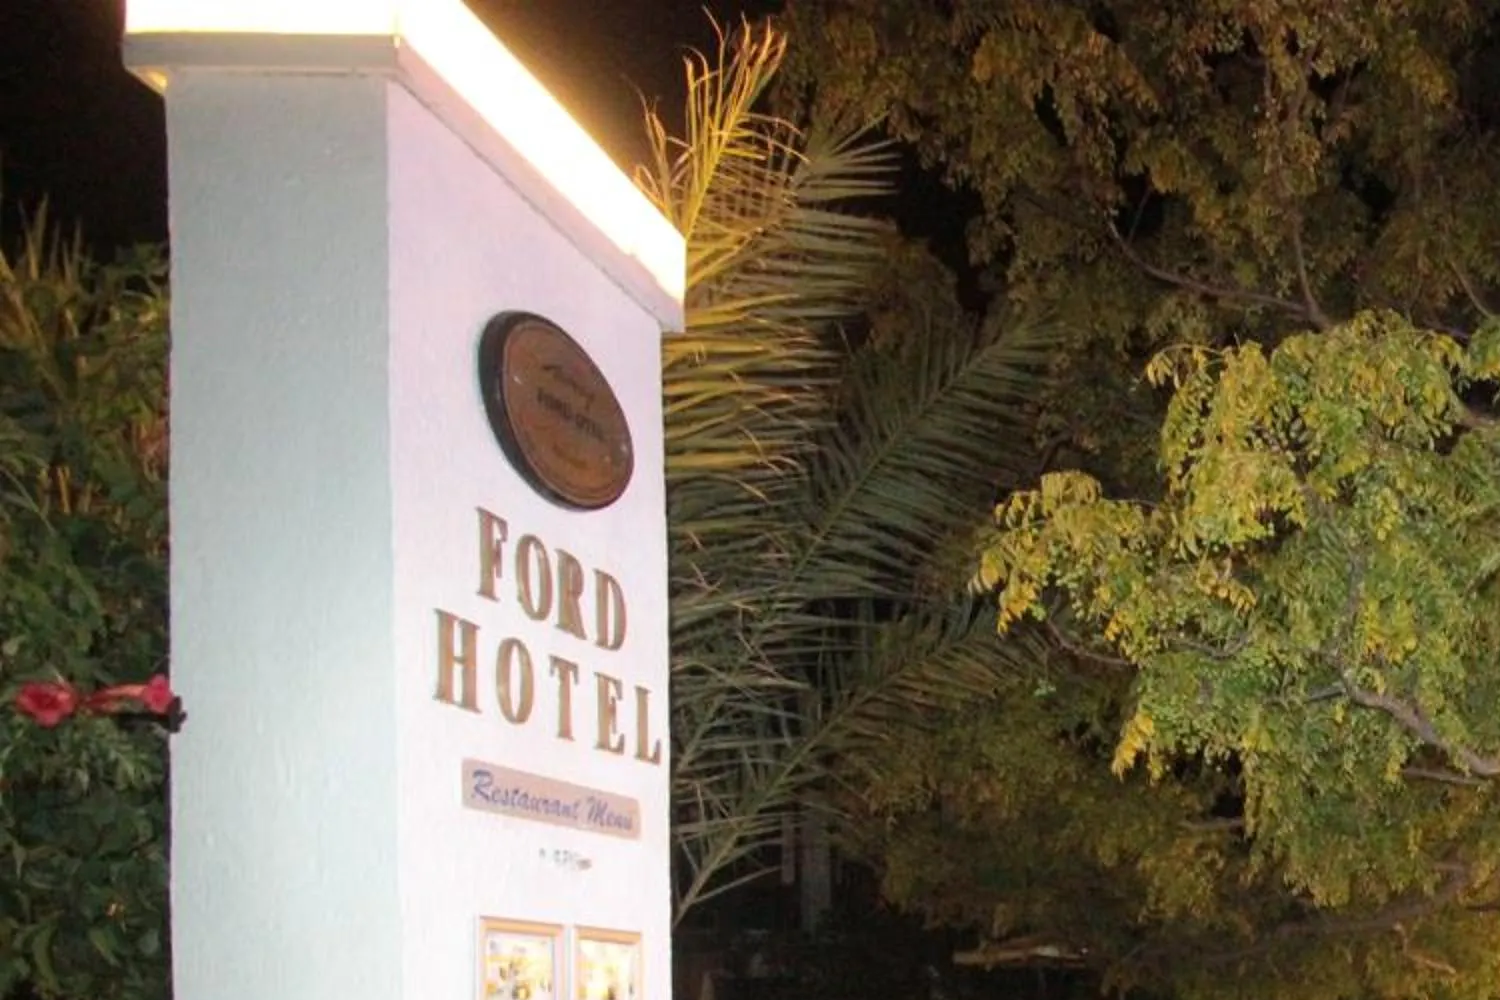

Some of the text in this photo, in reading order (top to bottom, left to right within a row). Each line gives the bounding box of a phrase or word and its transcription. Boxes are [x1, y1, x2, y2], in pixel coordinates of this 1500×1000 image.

[475, 506, 627, 652] FORD
[433, 608, 662, 765] HOTEL
[471, 768, 634, 831] Restaurant Menu
